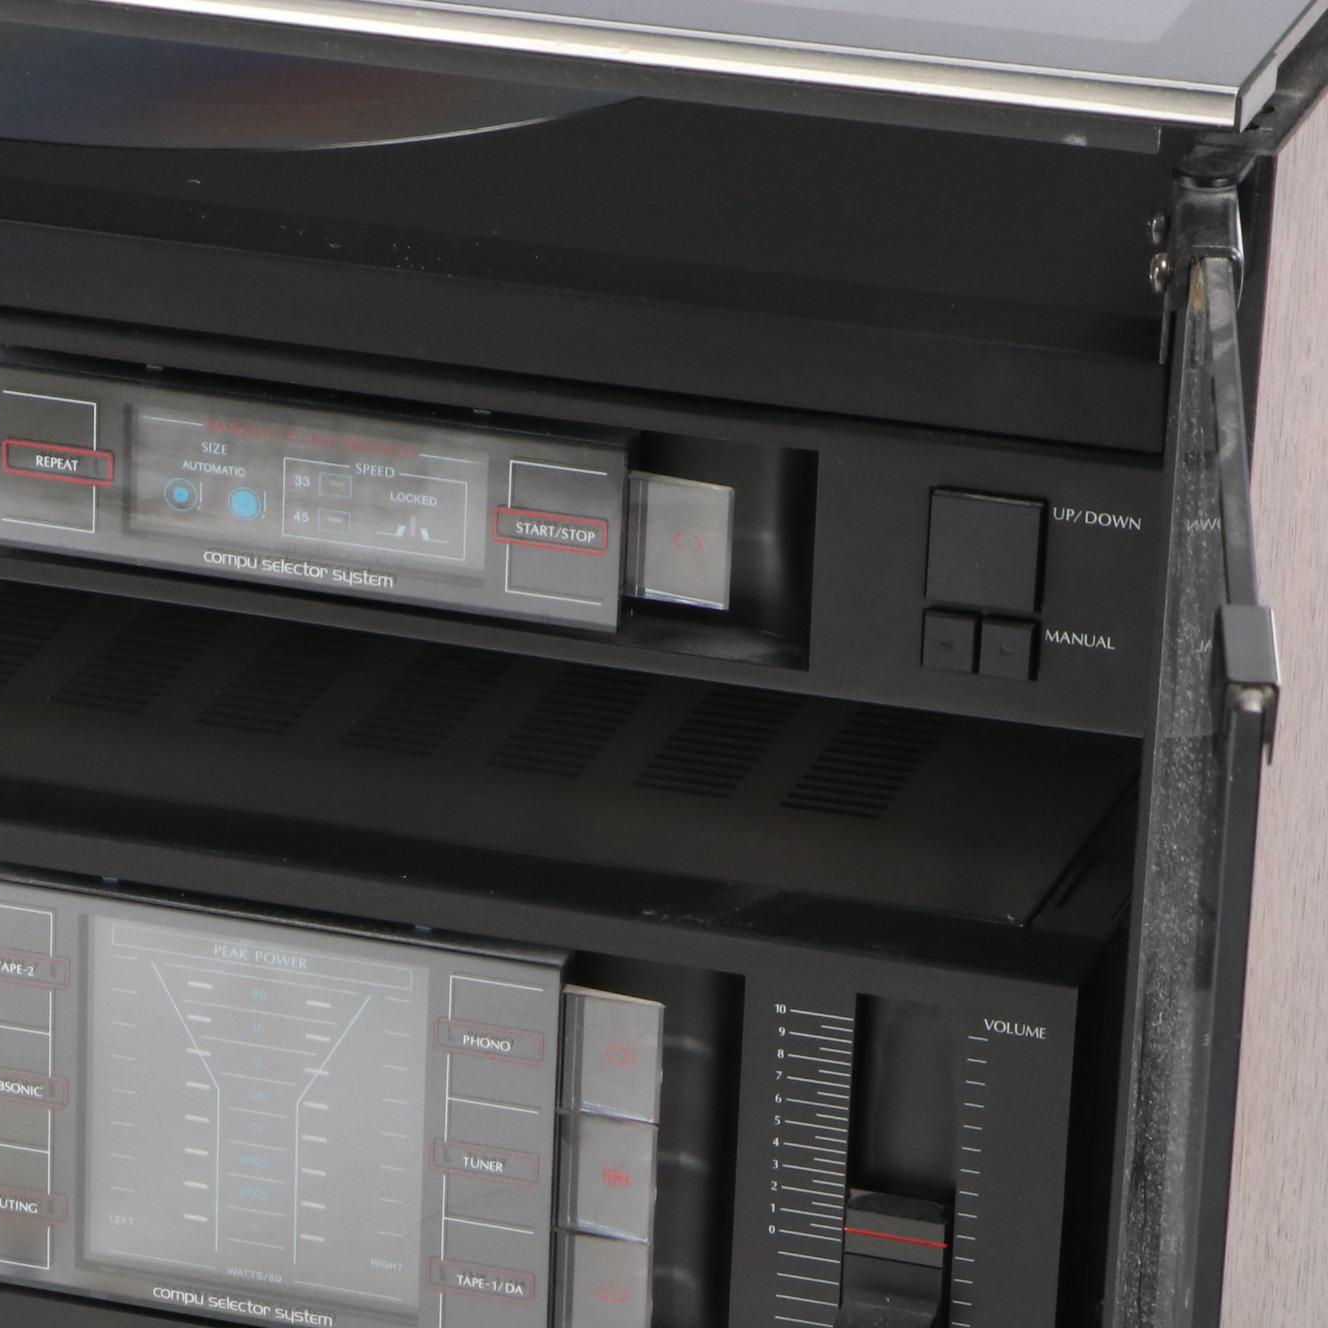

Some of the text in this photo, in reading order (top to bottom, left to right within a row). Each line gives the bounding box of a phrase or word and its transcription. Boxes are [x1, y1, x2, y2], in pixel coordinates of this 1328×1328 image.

[201, 441, 228, 455] SIZE
[35, 455, 78, 471] REPEAT
[182, 460, 246, 477] AUTOMATIC
[355, 463, 395, 478] SPEED
[389, 491, 437, 507] LOCKED
[1053, 507, 1142, 531] UP/DOWN
[516, 522, 596, 542] START/STOP
[203, 550, 393, 590] compu selector system
[1045, 629, 1115, 650] MANUAL
[213, 942, 308, 970] PEAK POWER
[984, 1019, 1046, 1040] VOLUME
[462, 1034, 510, 1052] PHONO
[462, 1156, 503, 1173] TUNER
[456, 1274, 523, 1295] TAPE-1/DA
[153, 1286, 333, 1327] compu selector system
